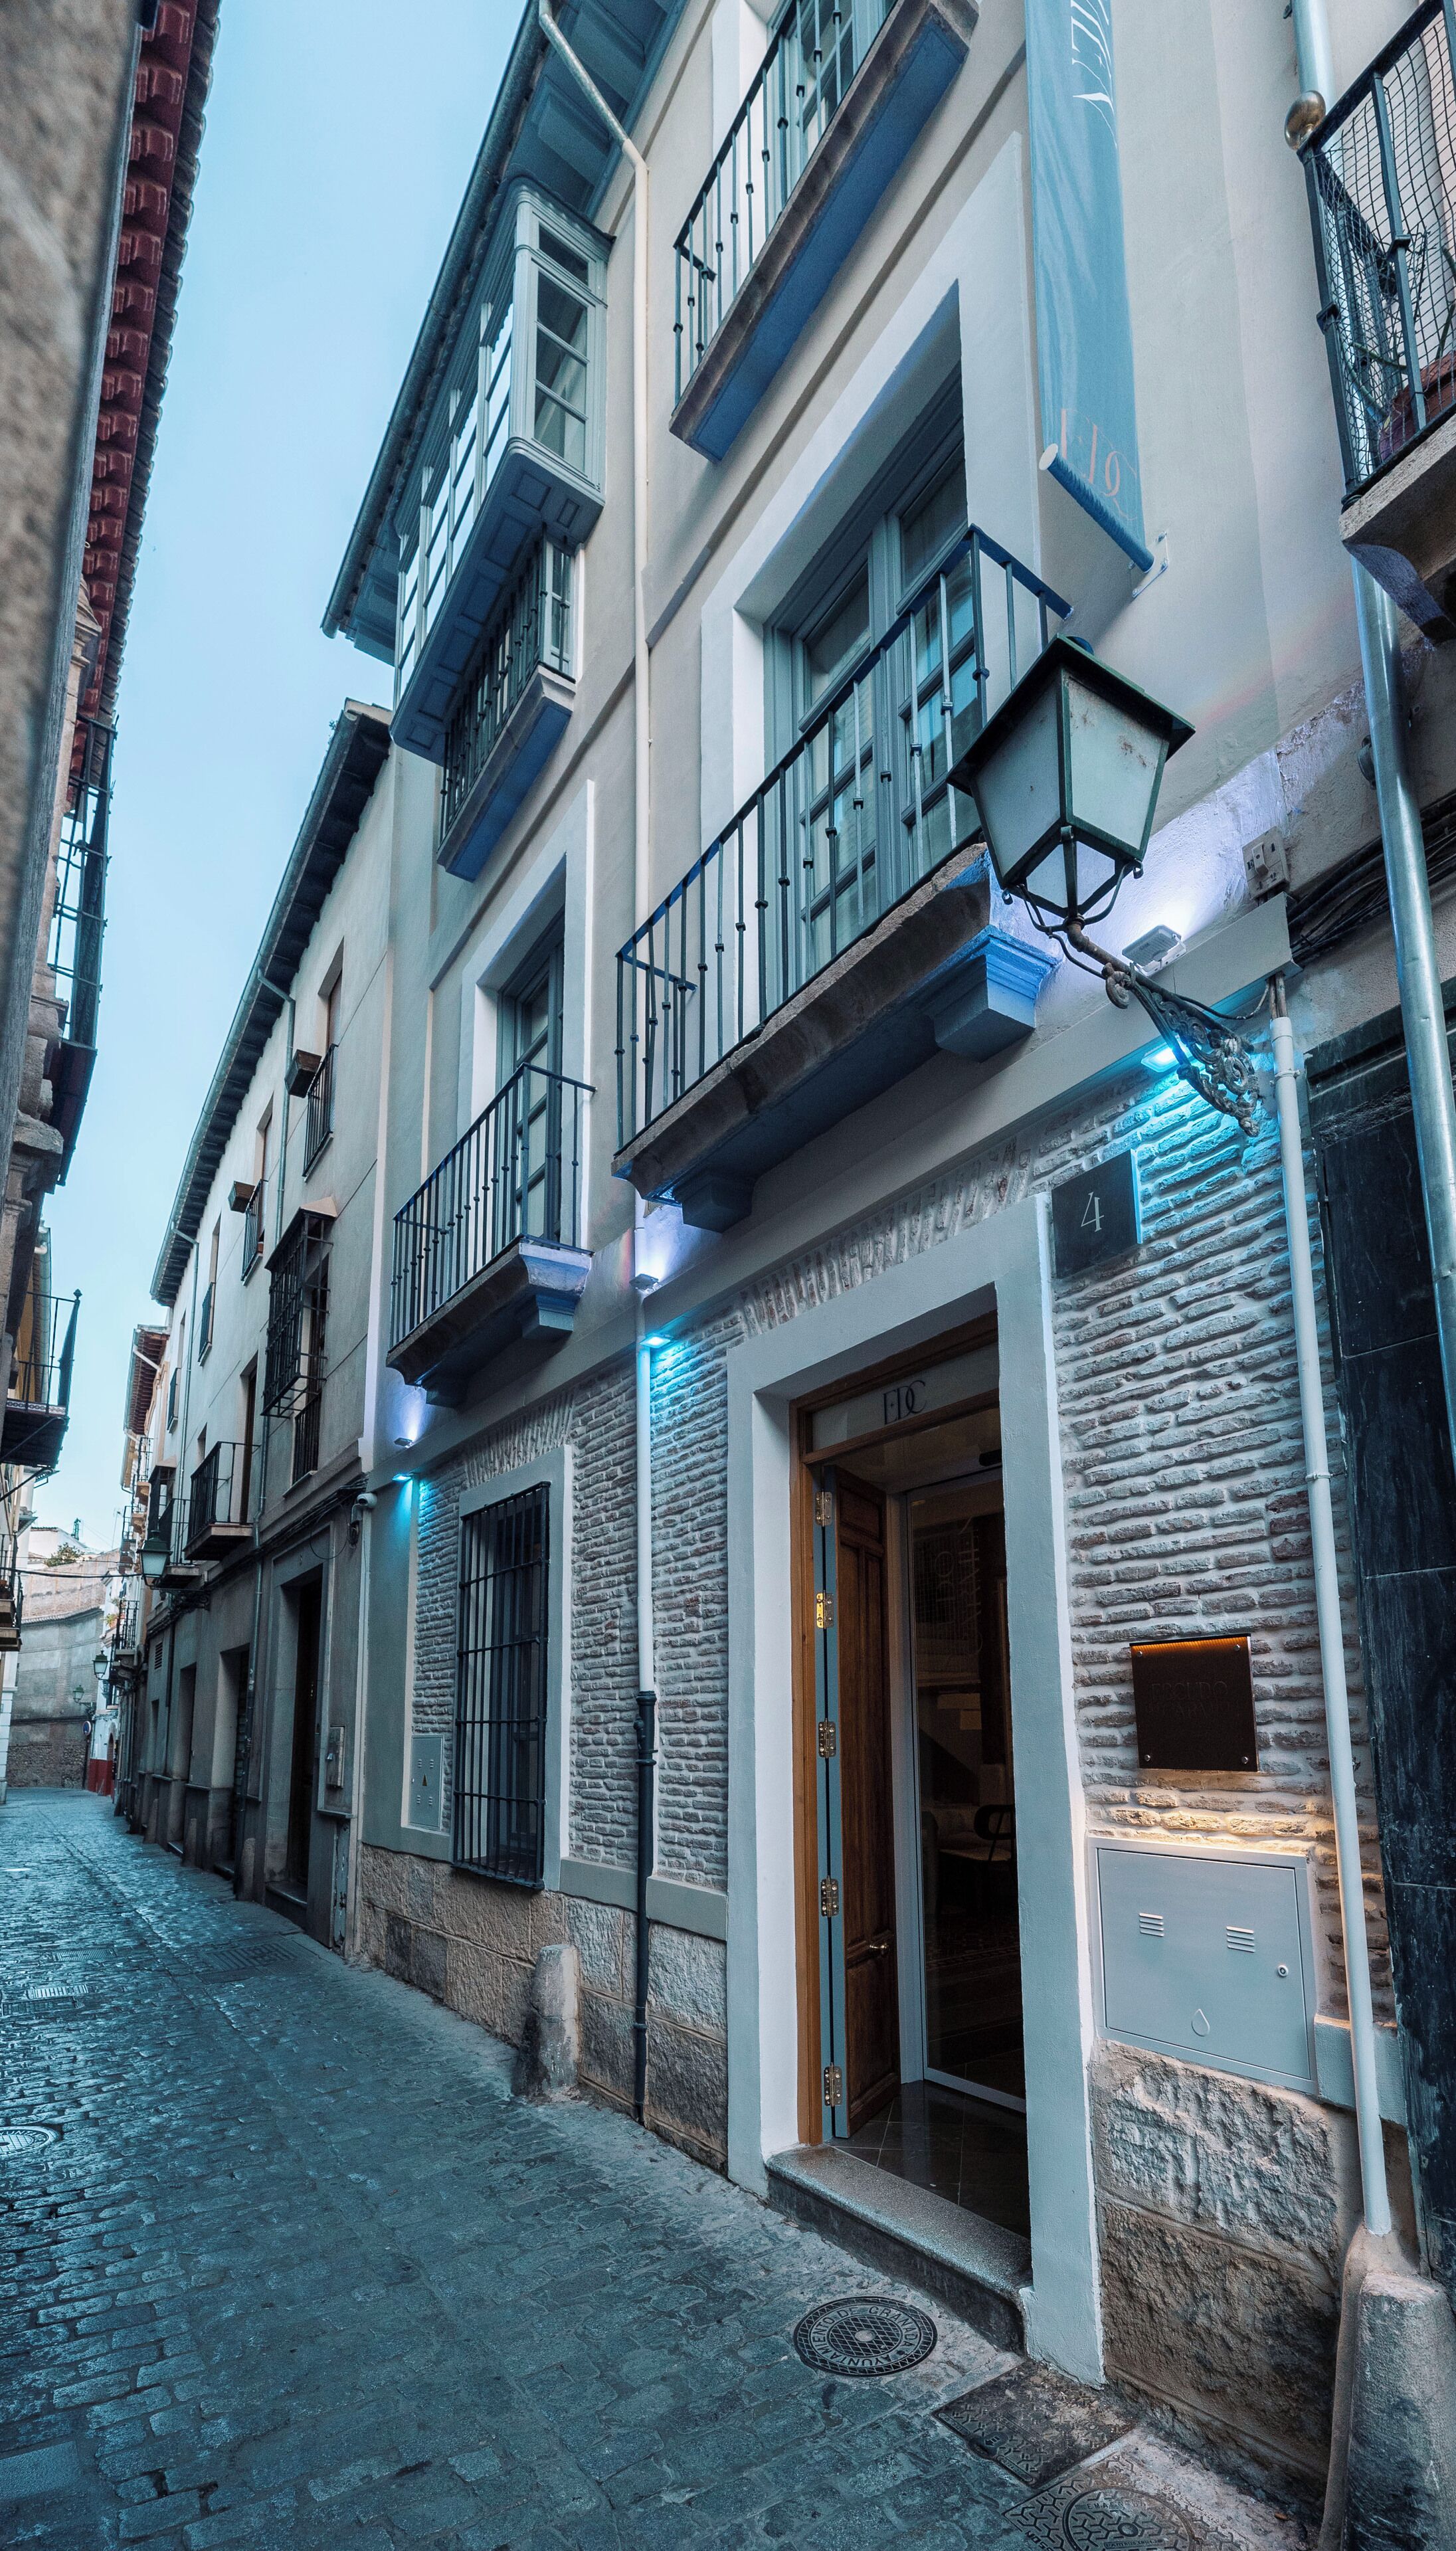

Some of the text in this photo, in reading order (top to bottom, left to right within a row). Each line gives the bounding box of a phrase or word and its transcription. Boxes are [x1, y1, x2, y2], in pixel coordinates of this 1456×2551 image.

[1081, 1191, 1105, 1232] 4
[811, 2305, 919, 2367] AYUNTAMIENTO DE GRANADA
